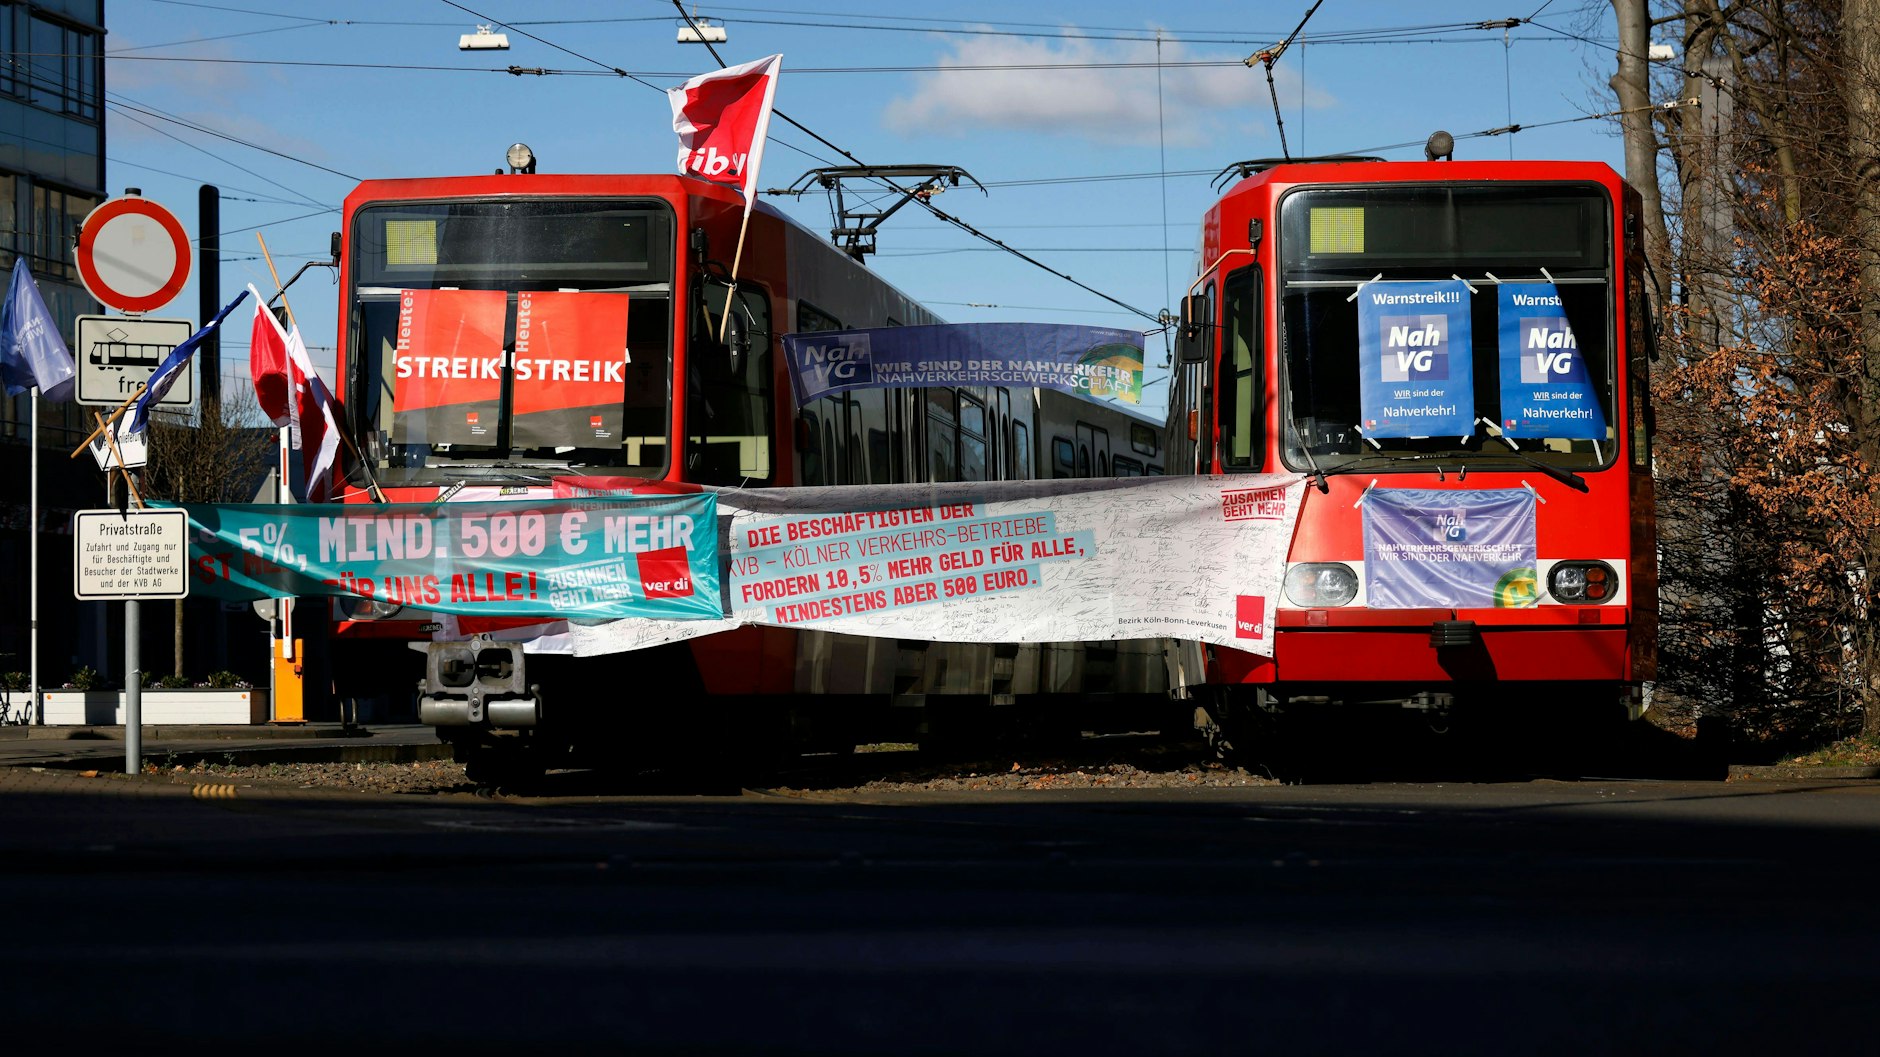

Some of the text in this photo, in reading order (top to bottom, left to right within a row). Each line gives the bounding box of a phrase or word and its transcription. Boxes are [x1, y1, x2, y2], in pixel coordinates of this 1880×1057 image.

[1372, 291, 1460, 305] Warnstreik!!!
[397, 291, 413, 350] Heute:
[516, 293, 531, 352] Heute:
[1388, 323, 1441, 347] Nah
[1528, 327, 1577, 349] Nah
[804, 344, 865, 366] Nah
[1397, 350, 1433, 372] VG
[1536, 352, 1572, 374] VG
[397, 357, 499, 379] STREIK
[515, 358, 624, 383] STREIK
[813, 360, 857, 384] VG
[875, 359, 1131, 384] WIR SIND DER NAHVERKEHR
[118, 376, 149, 393] fre
[877, 371, 1132, 395] NAHVERKEHRSGEWERKSCHAFT
[1394, 389, 1444, 399] WIR sind der
[1533, 391, 1583, 400] WIR sind der
[1383, 404, 1456, 418] Nahverkehr!
[1523, 407, 1593, 419] Nahverkehr!
[1221, 488, 1286, 507] ZUSAMMEN
[1223, 502, 1286, 518] GEHT MEHR
[1436, 514, 1465, 526] Nah
[99, 523, 163, 536] Privatstraße
[318, 514, 447, 563] MIND.
[461, 510, 546, 558] 500
[560, 509, 588, 556] €
[604, 514, 695, 554] MEHR
[747, 525, 782, 549] DIE
[787, 507, 934, 541] BESCHÄFTIGTEN
[940, 502, 975, 521] DER
[1440, 526, 1460, 538] VG
[86, 542, 177, 553] Zufahrt und Zugang nur
[726, 556, 759, 577] KVB
[783, 541, 850, 569] KÖLNER
[856, 516, 1048, 557] VERKEHRS-BETRIEBE
[1378, 543, 1522, 553] NAHVERKEHRSGEWERKSCHAFT
[1379, 552, 1522, 563] WIR SIND DER NAHVERKEHR
[92, 554, 170, 565] für Beschäftigte und
[741, 537, 1085, 603] FORDERN 10,5% MEHR GELD FÜR ALLE,
[84, 566, 178, 576] Besucher der Stadtwerke
[547, 562, 628, 590] ZUSAMMEN
[100, 578, 162, 588] und der KVB AG
[385, 575, 441, 606] UNS
[451, 571, 538, 604] ALLE!
[645, 577, 689, 592] ver.di
[549, 583, 633, 610] GEHT MEHR
[775, 568, 1037, 624] MINDESTENS ABER 500 EURO.
[1118, 616, 1228, 631] Bezirk Köln-Bonn-Leverkusen
